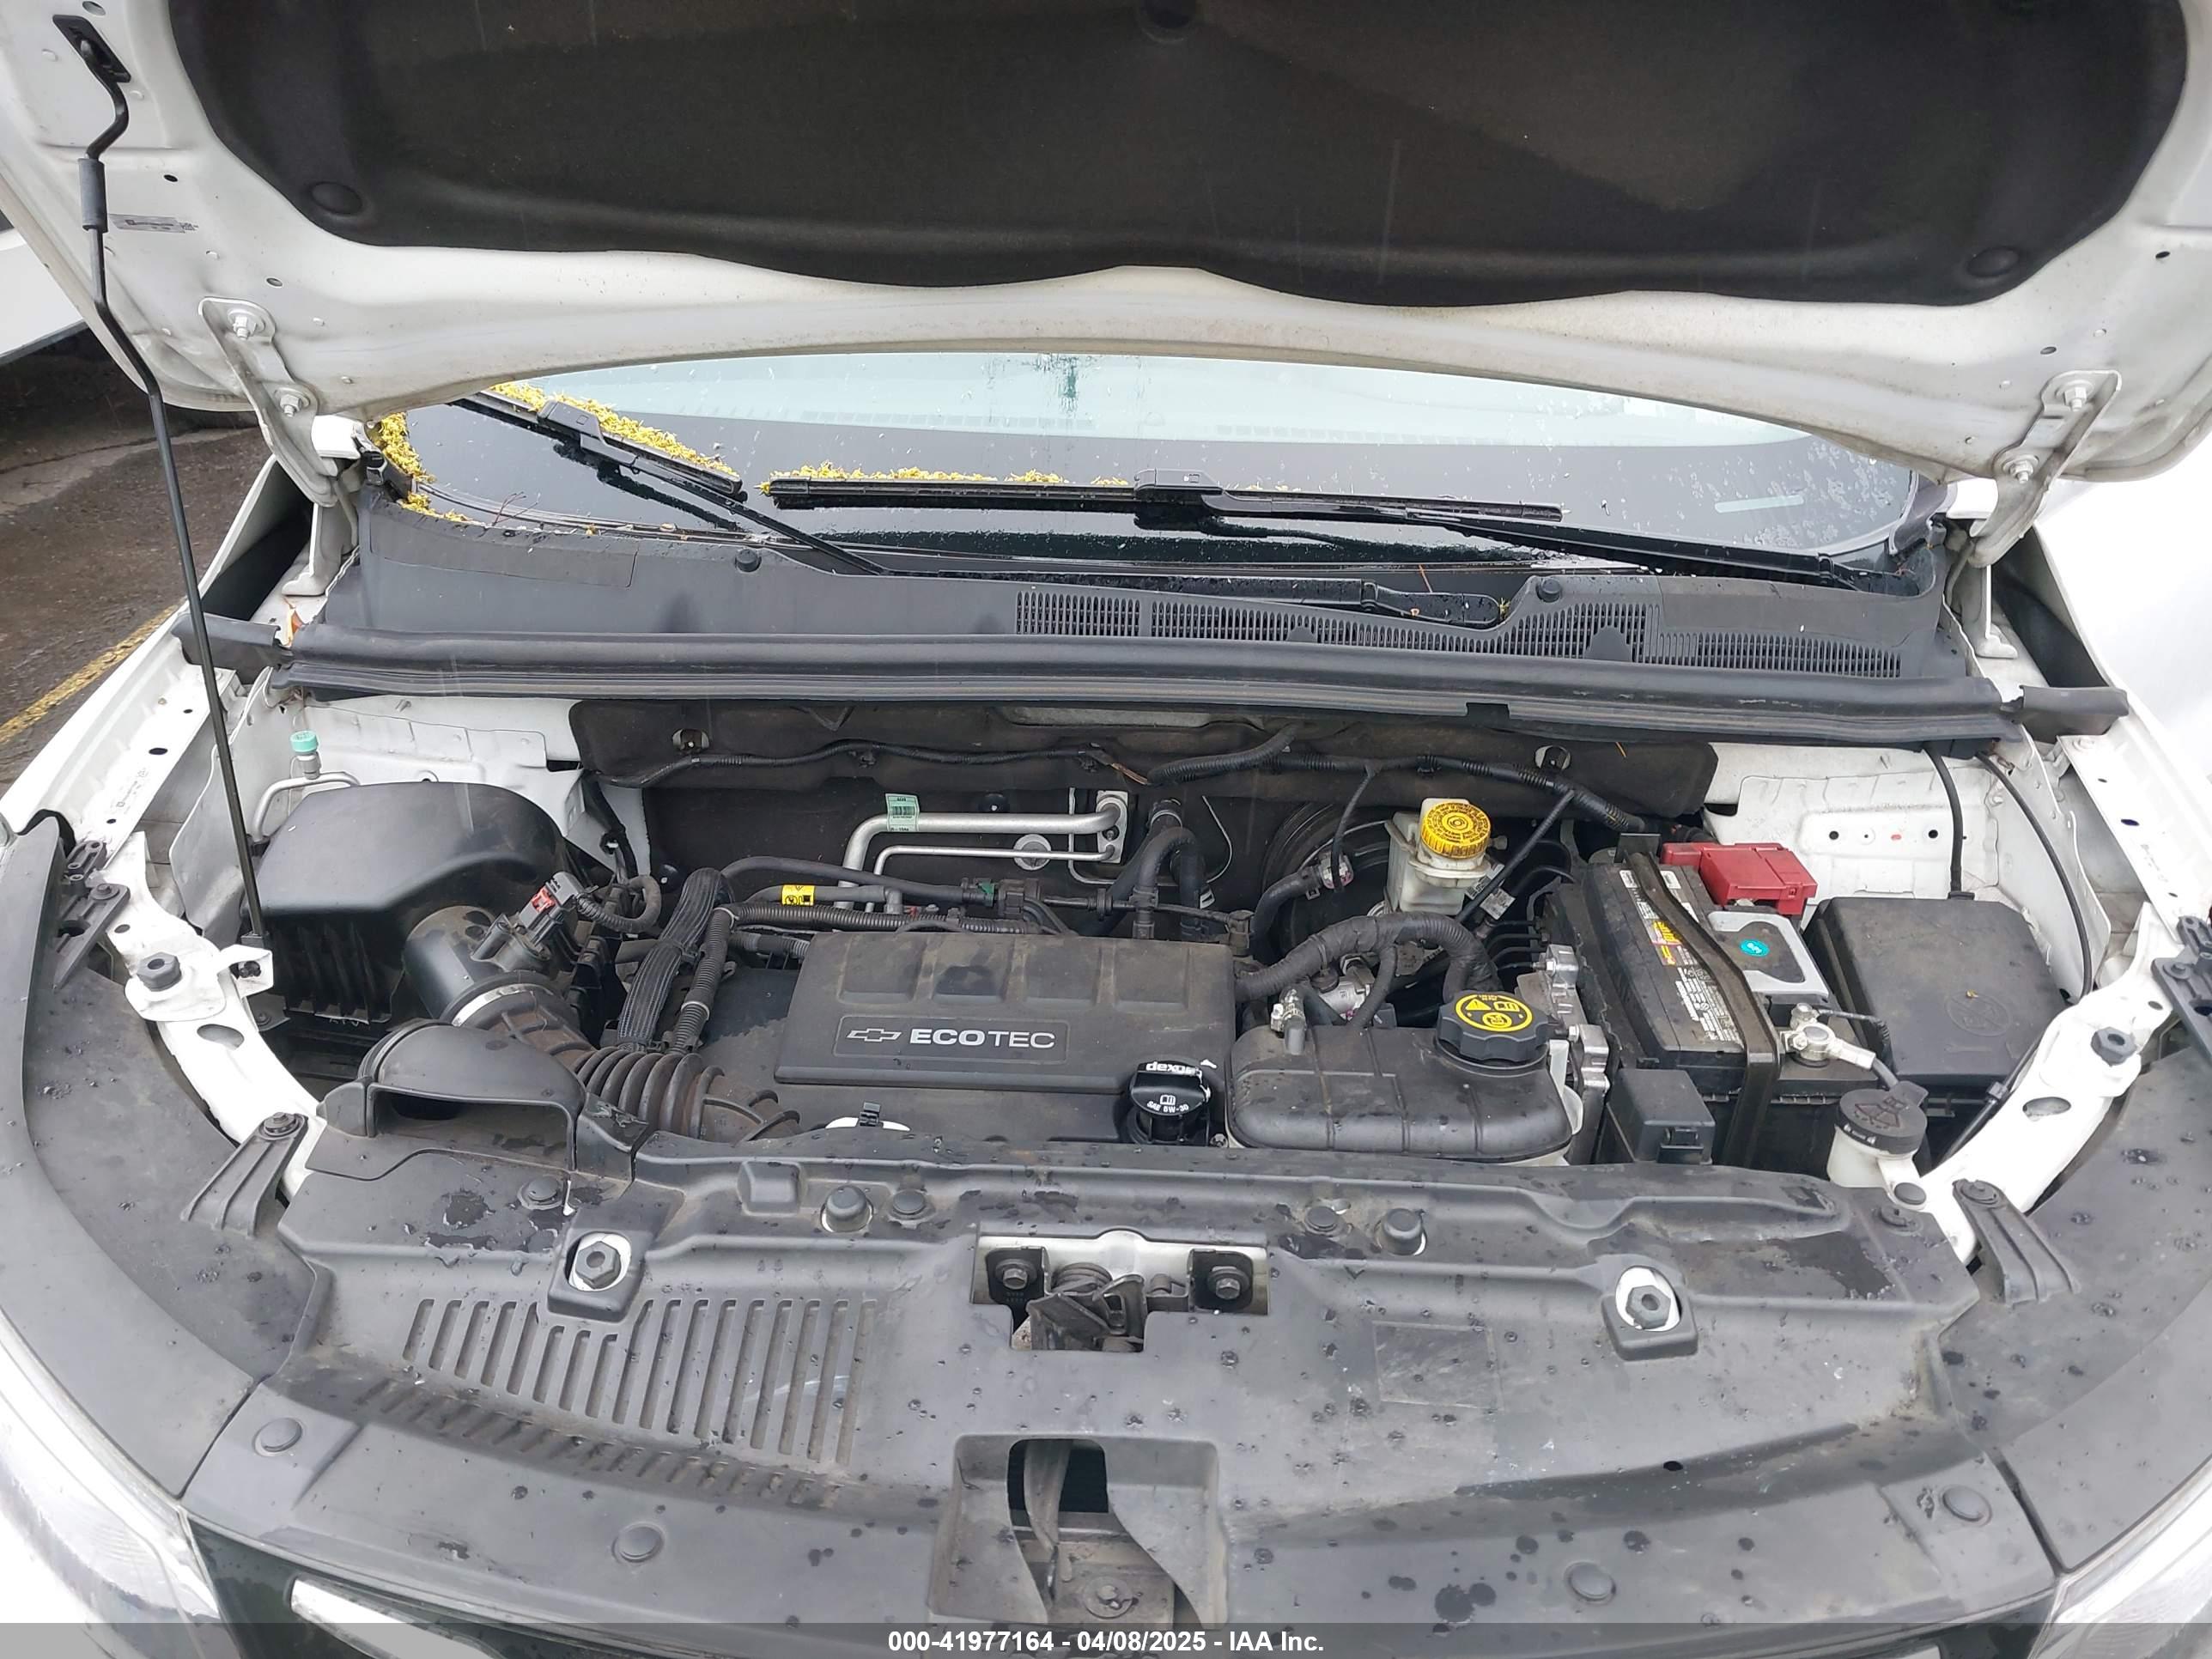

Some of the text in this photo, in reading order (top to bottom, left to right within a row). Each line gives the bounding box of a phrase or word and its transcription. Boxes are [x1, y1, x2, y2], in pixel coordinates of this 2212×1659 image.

[909, 1028, 1055, 1048] ECOTEC
[1146, 1100, 1189, 1113] SAE 5W-30
